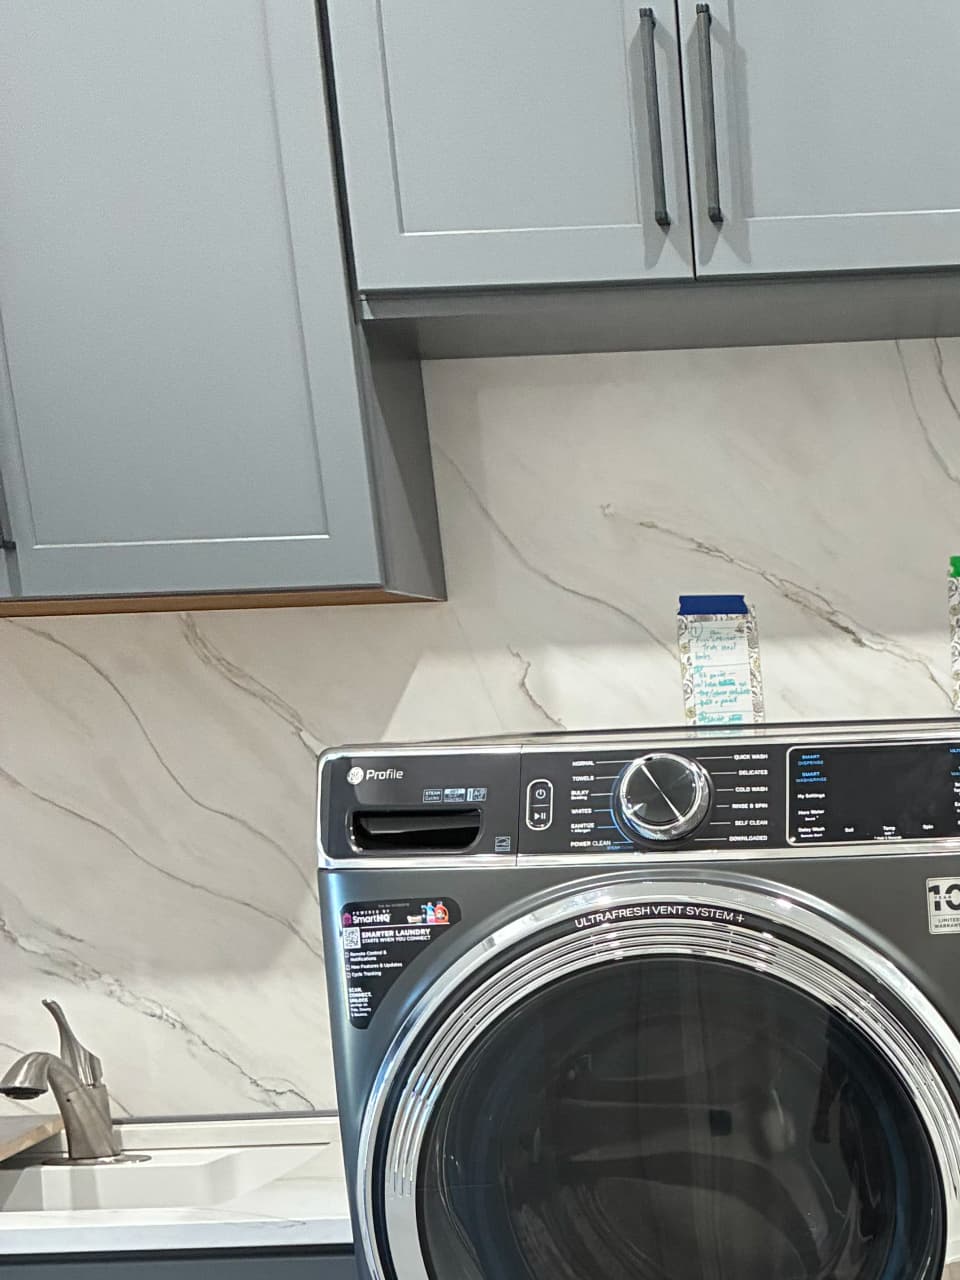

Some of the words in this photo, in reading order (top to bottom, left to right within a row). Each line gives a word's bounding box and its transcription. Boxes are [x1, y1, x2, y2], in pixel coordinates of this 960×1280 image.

[366, 768, 404, 780] Profile
[352, 913, 391, 924] SmartHQ
[574, 906, 650, 928] ULTRAFRESH
[651, 905, 684, 915] VENT
[686, 906, 734, 921] SYSTEM
[361, 930, 394, 939] SMARTER
[395, 928, 431, 937] LAUNDRY
